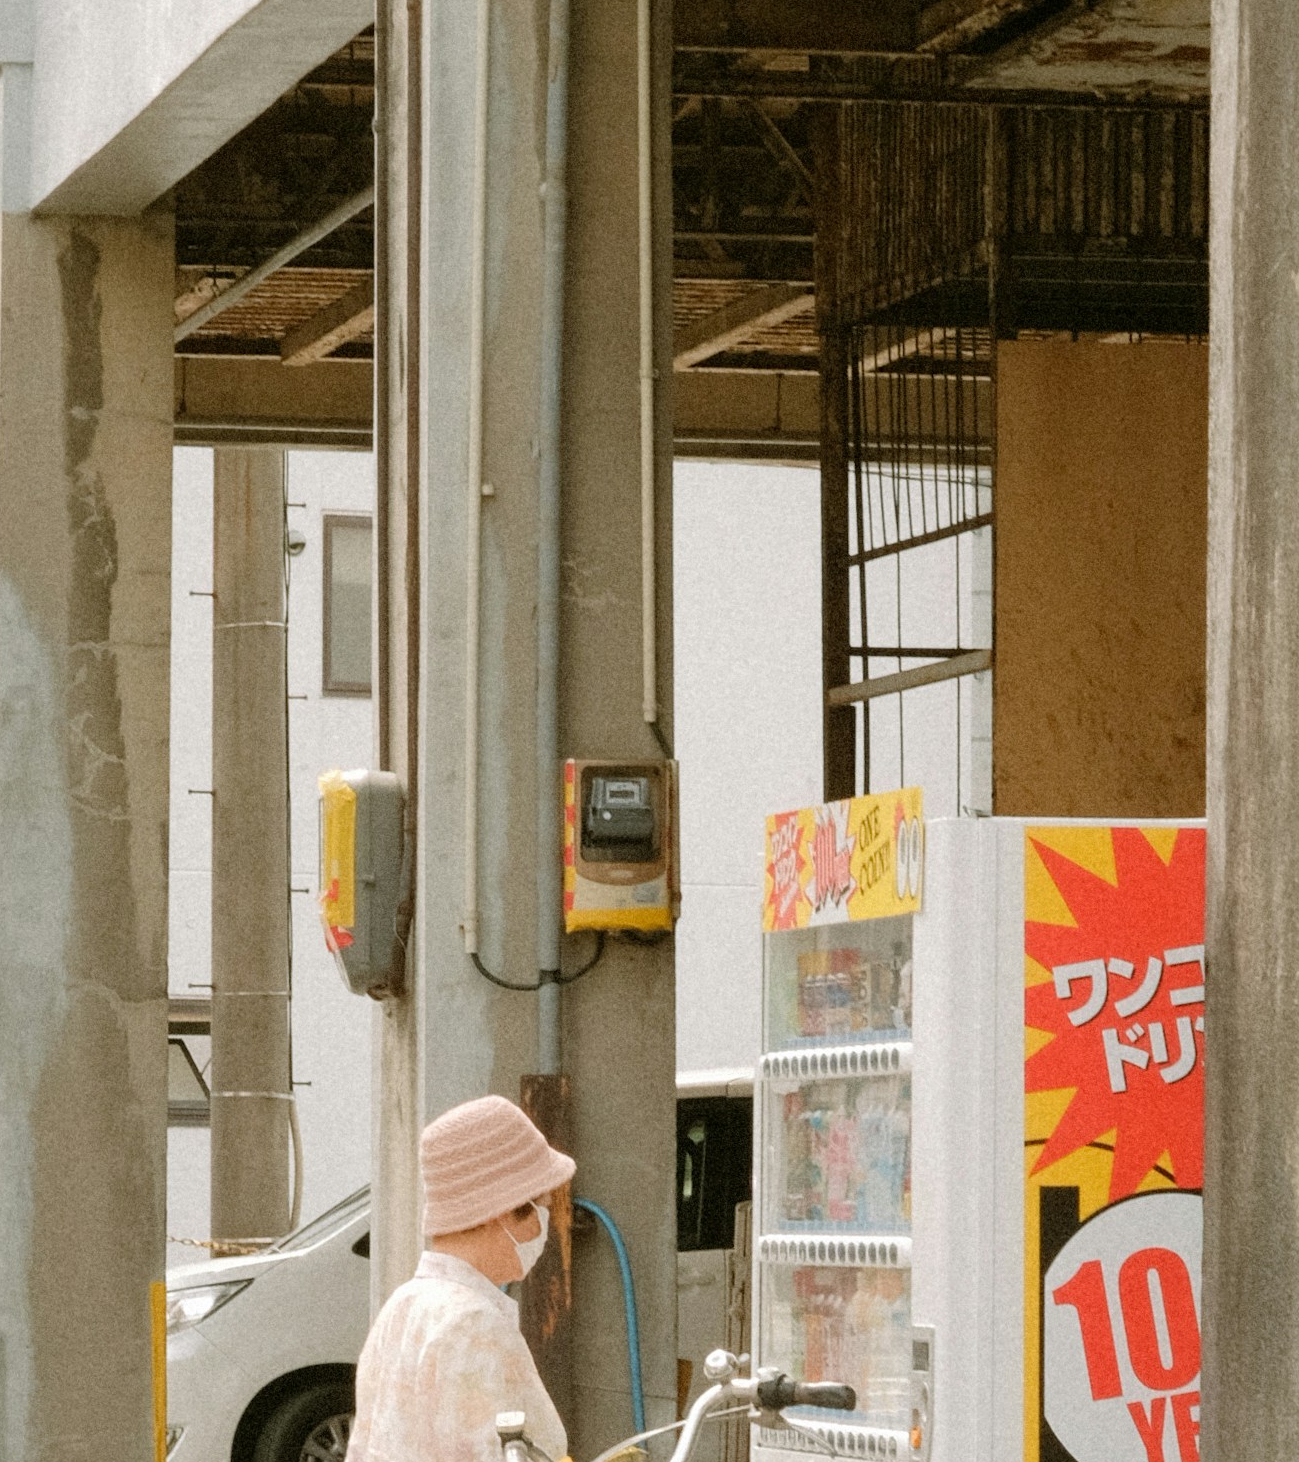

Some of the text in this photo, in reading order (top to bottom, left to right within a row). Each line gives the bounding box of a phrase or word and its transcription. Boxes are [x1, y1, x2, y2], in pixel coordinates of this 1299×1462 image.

[859, 806, 880, 851] ONE
[1102, 1016, 1204, 1093] ドリ
[1053, 1247, 1202, 1401] 10
